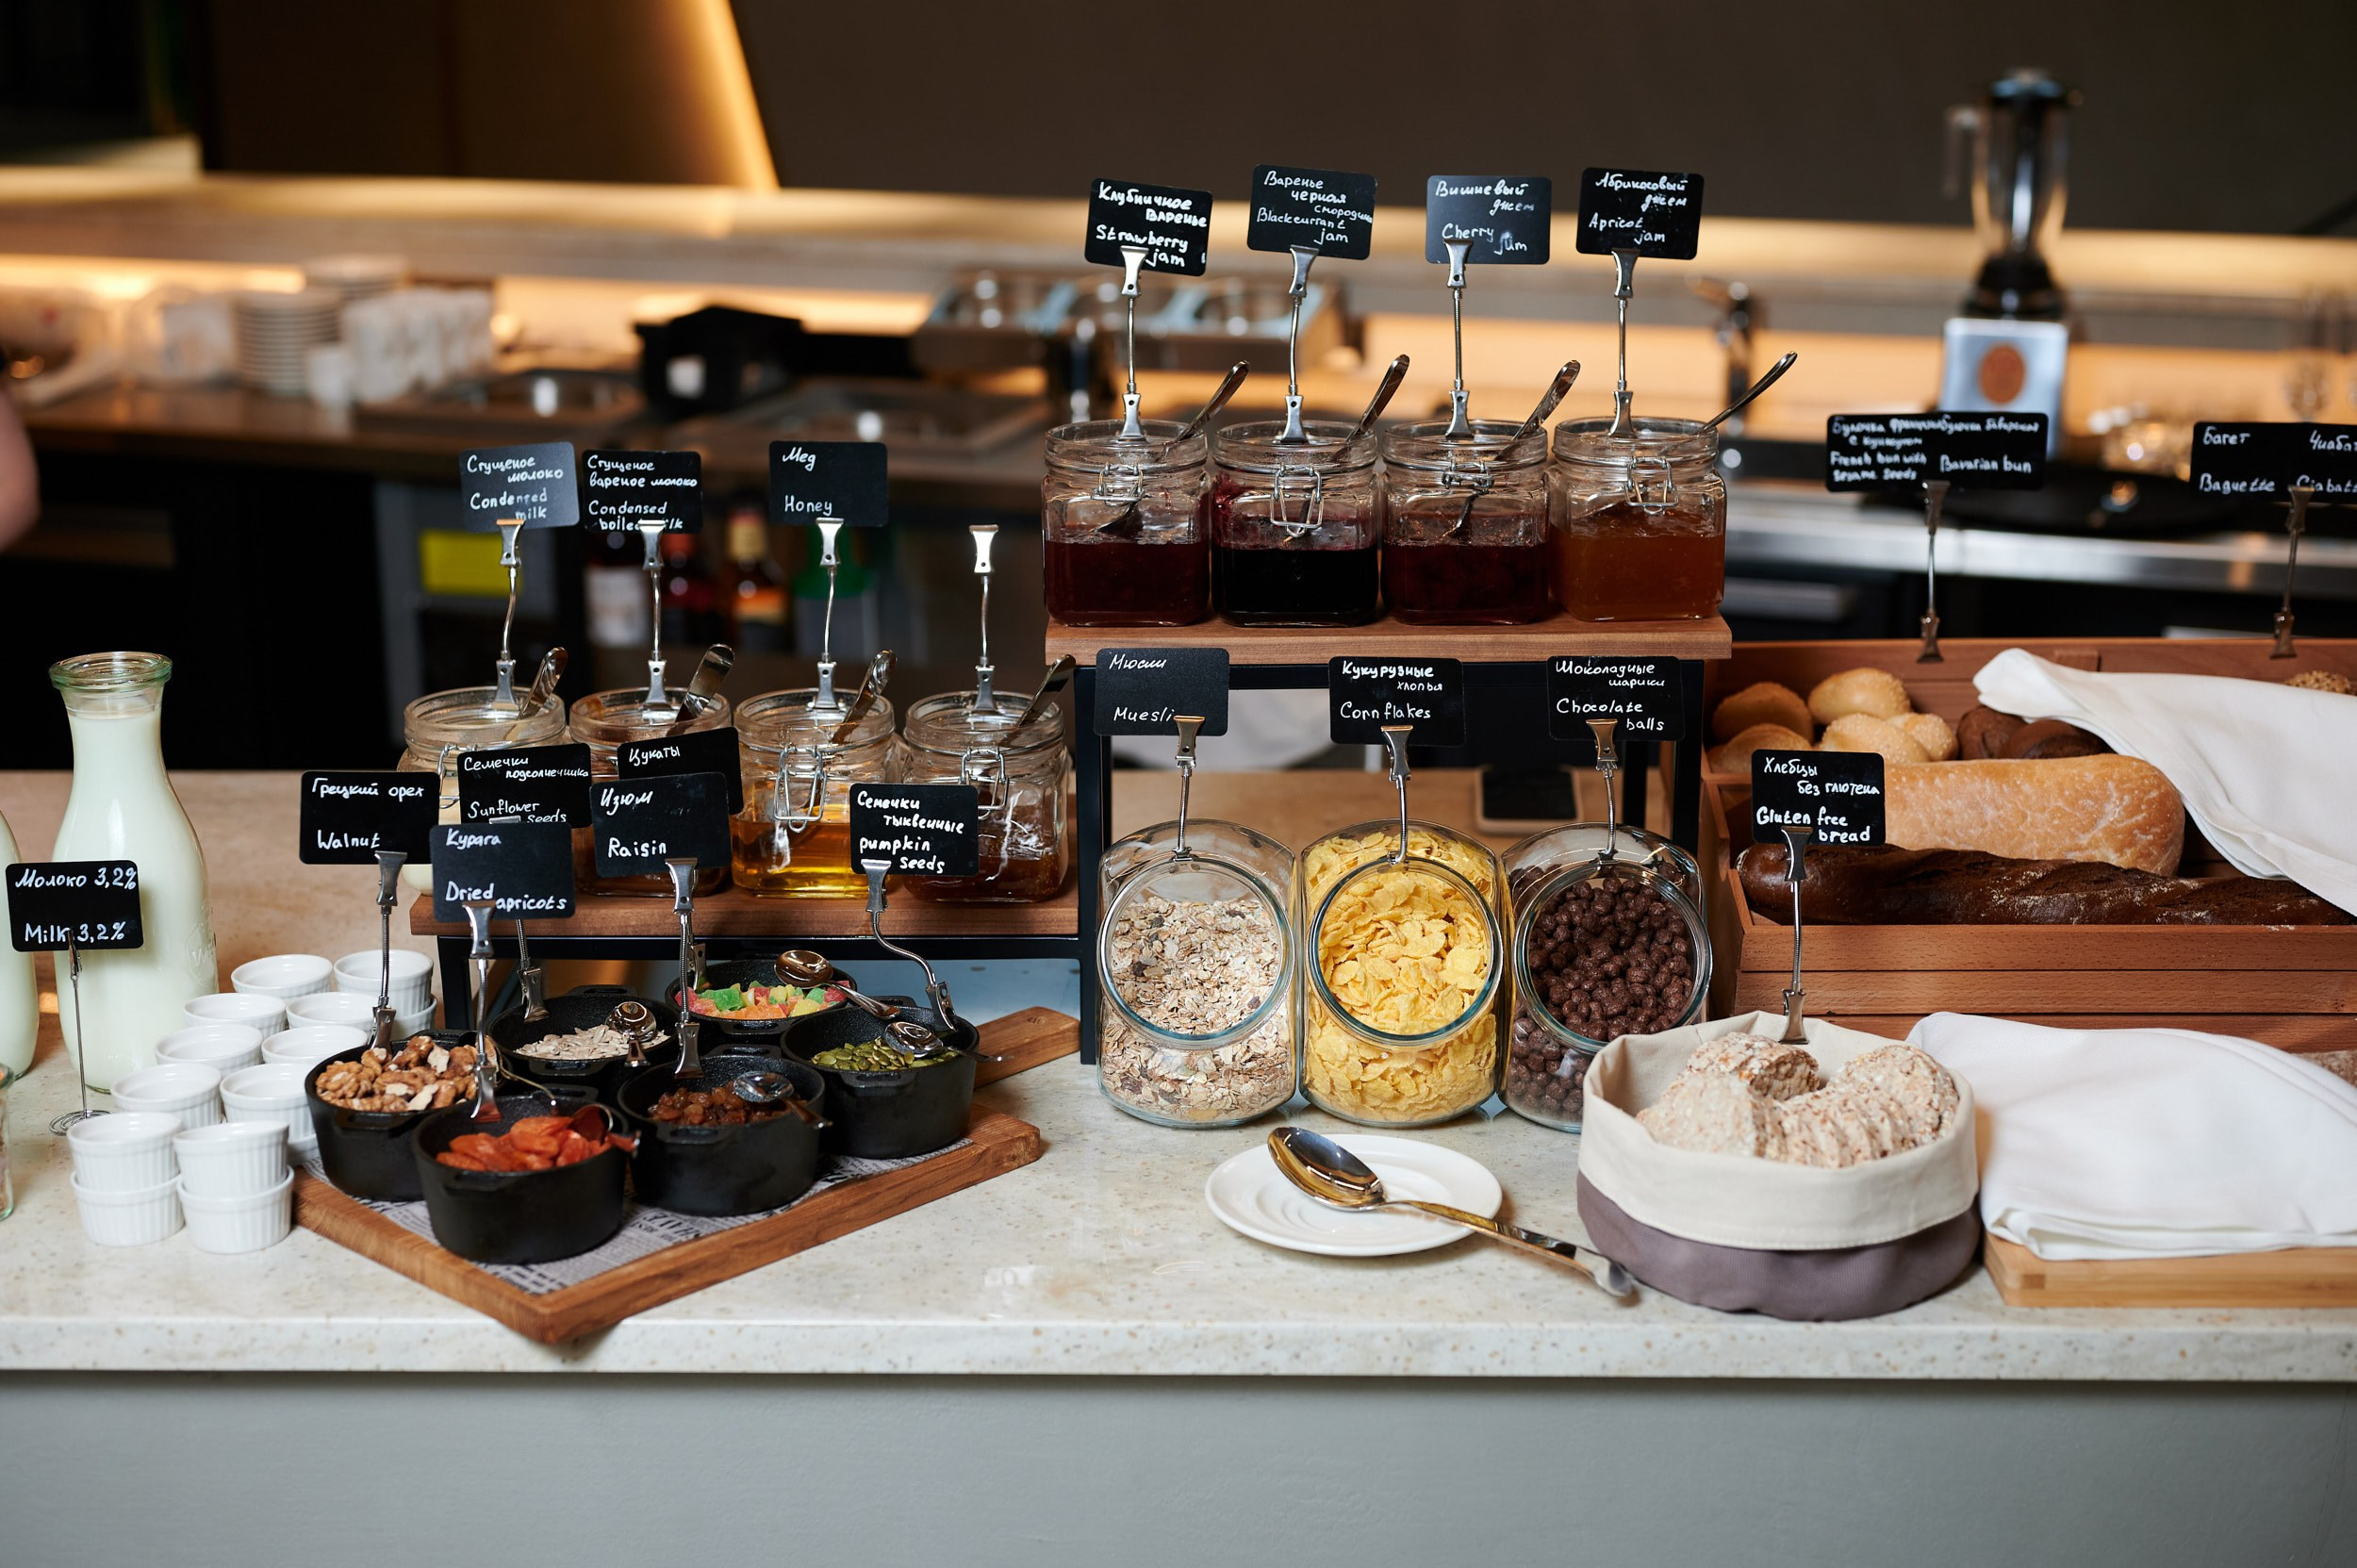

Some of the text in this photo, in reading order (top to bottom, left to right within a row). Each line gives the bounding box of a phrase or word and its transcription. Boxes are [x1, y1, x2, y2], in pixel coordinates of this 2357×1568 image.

[1263, 170, 1324, 190] Варенье
[1435, 179, 1529, 197] Вишневый
[1595, 172, 1689, 191] Абрикосовый
[1098, 181, 1193, 210] Клубничное
[1291, 190, 1346, 204] черная
[1640, 194, 1687, 212] джем
[1256, 206, 1346, 229] Blackcurrant
[1489, 199, 1534, 216] джем
[1588, 212, 1643, 231] Apricot
[1096, 223, 1188, 254] Strawberry
[1312, 227, 1349, 245] jam
[1442, 223, 1494, 243] Cherry
[1633, 229, 1666, 245] jam
[1145, 248, 1185, 268] jam
[2202, 426, 2251, 445] Багет
[467, 454, 536, 475] Сгущеное
[587, 454, 655, 473] Сгущеное
[782, 446, 816, 472] Мед
[2003, 454, 2032, 474] bun
[507, 469, 564, 484] молоко
[651, 477, 699, 487] молоко
[2199, 472, 2276, 495] Baguette
[515, 505, 549, 520] milk
[588, 501, 668, 516] Condensed
[784, 495, 832, 517] Honey
[1109, 653, 1167, 670] Мюсли
[1342, 660, 1435, 680] Кукурузные
[1556, 660, 1656, 678] Шоколадные
[1396, 681, 1443, 692] хлопья
[1608, 678, 1665, 689] шарики
[1113, 706, 1175, 722] Muesli
[1557, 698, 1643, 714] Chocolate
[1626, 717, 1665, 731] balls
[464, 756, 529, 771] Семечки
[628, 746, 681, 767] Цукаты
[505, 767, 589, 782] подсолнечника
[1763, 756, 1818, 778] Хлебцы
[311, 777, 424, 802] Грецкий орех
[1797, 780, 1881, 797] без глютена
[468, 799, 540, 819] Sunflower
[600, 787, 654, 816] Изюм
[857, 790, 920, 810] Семечки
[882, 813, 964, 834] тыквенные
[1756, 805, 1849, 827] Gluten free
[317, 829, 381, 850] Walnut
[445, 827, 503, 850] Курага
[1818, 825, 1871, 844] bread
[607, 836, 668, 859] Raisin
[15, 867, 137, 890] Молоко 3,2%
[445, 880, 568, 913] Dried apricots
[25, 920, 126, 944] Milk 3,2%
